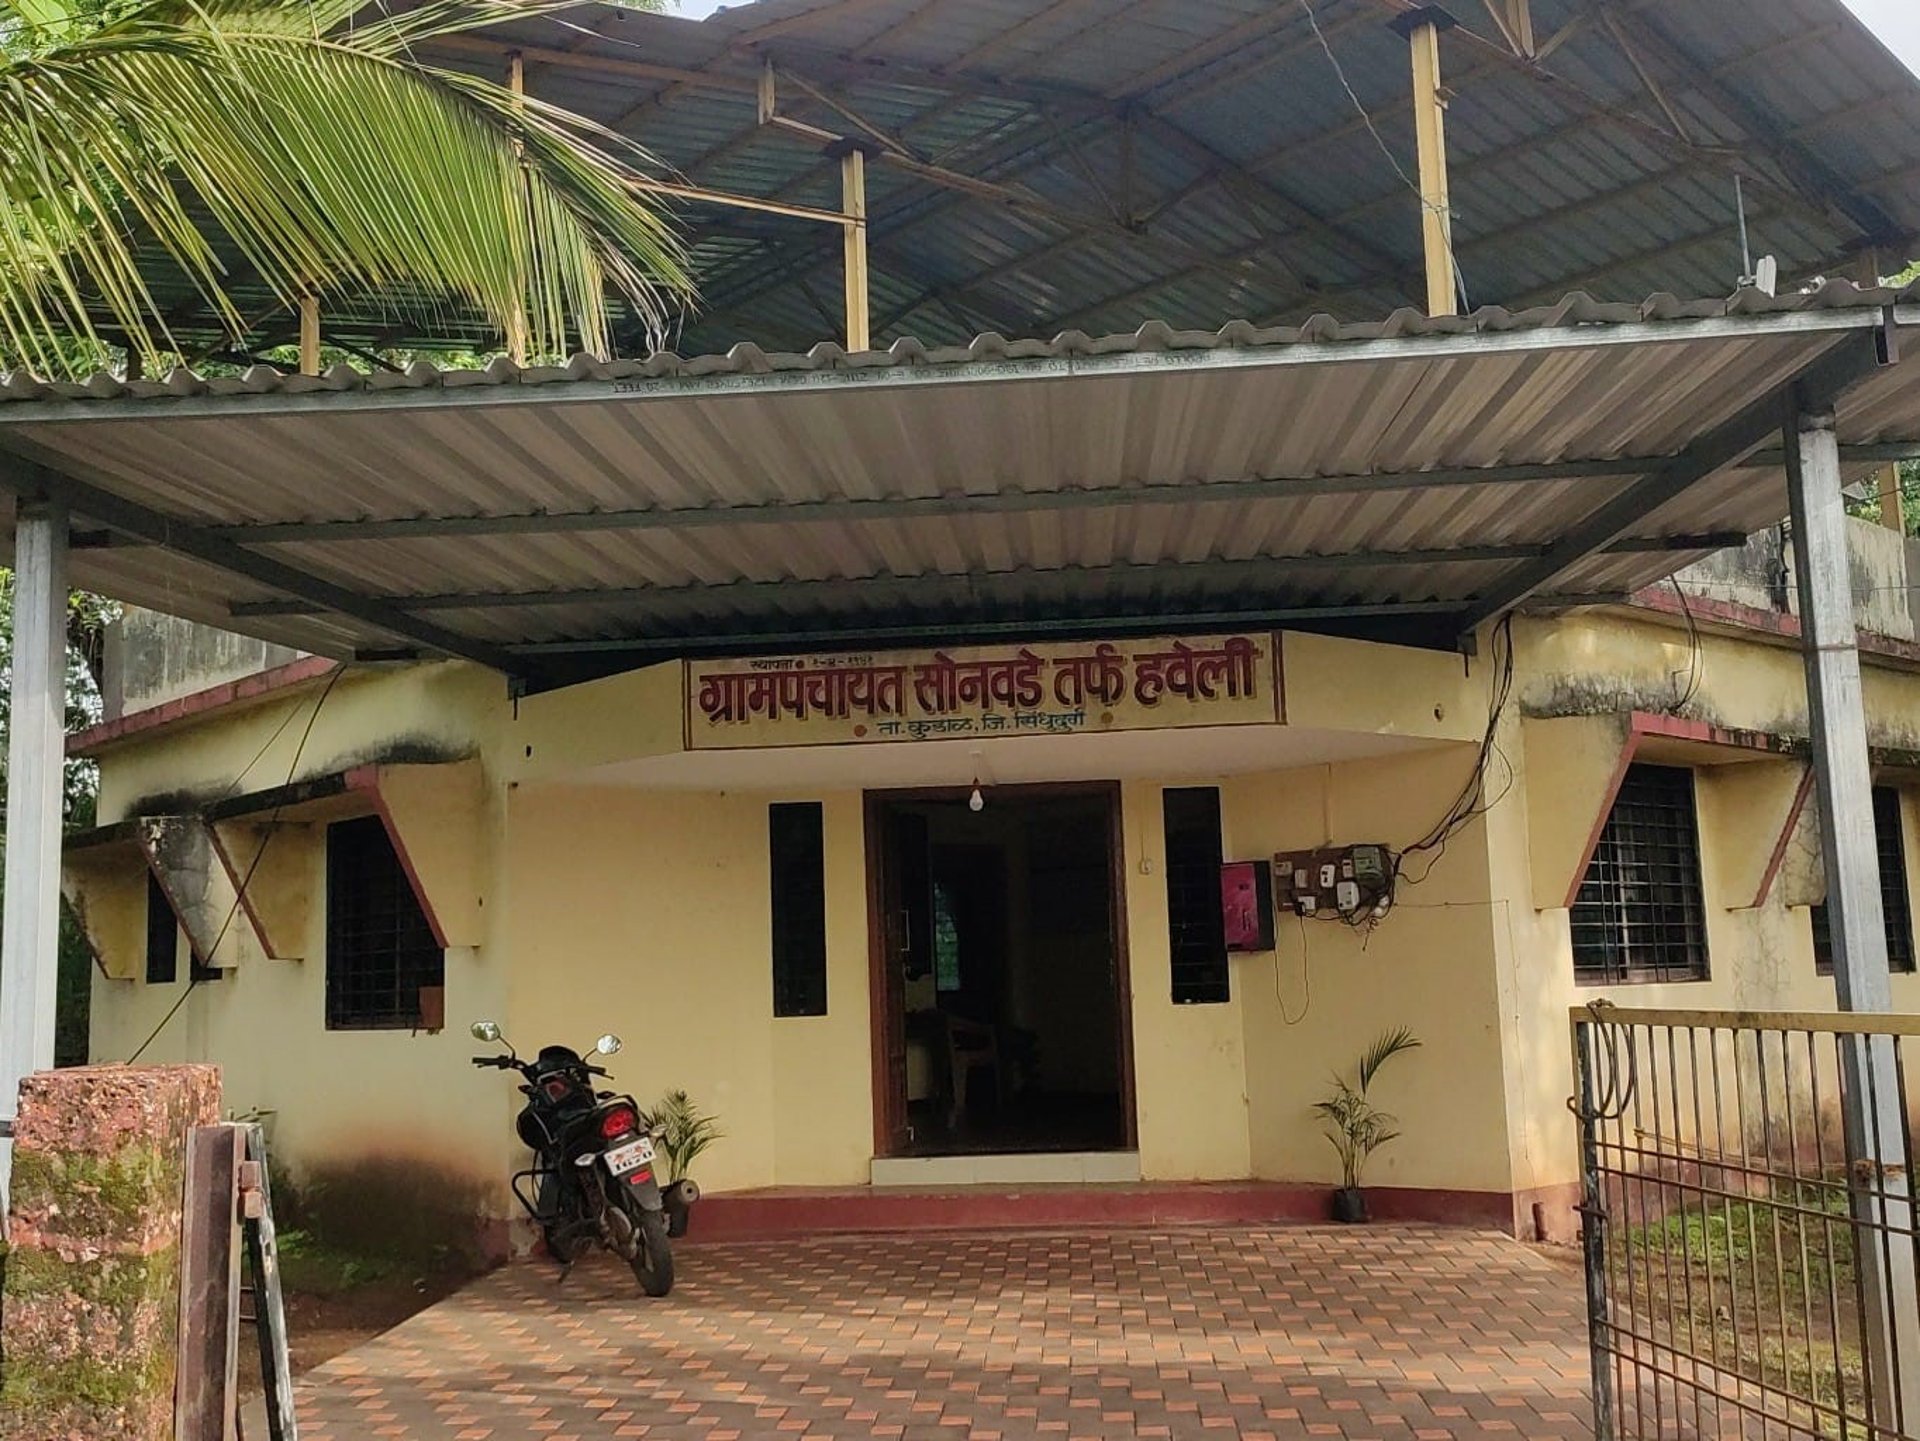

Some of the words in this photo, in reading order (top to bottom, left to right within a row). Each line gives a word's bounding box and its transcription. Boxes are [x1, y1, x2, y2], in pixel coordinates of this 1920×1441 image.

[613, 382, 641, 394] FEET
[913, 648, 1046, 712] सोनवडे
[1052, 643, 1125, 706] तर्फ
[1133, 636, 1264, 705] हवेली
